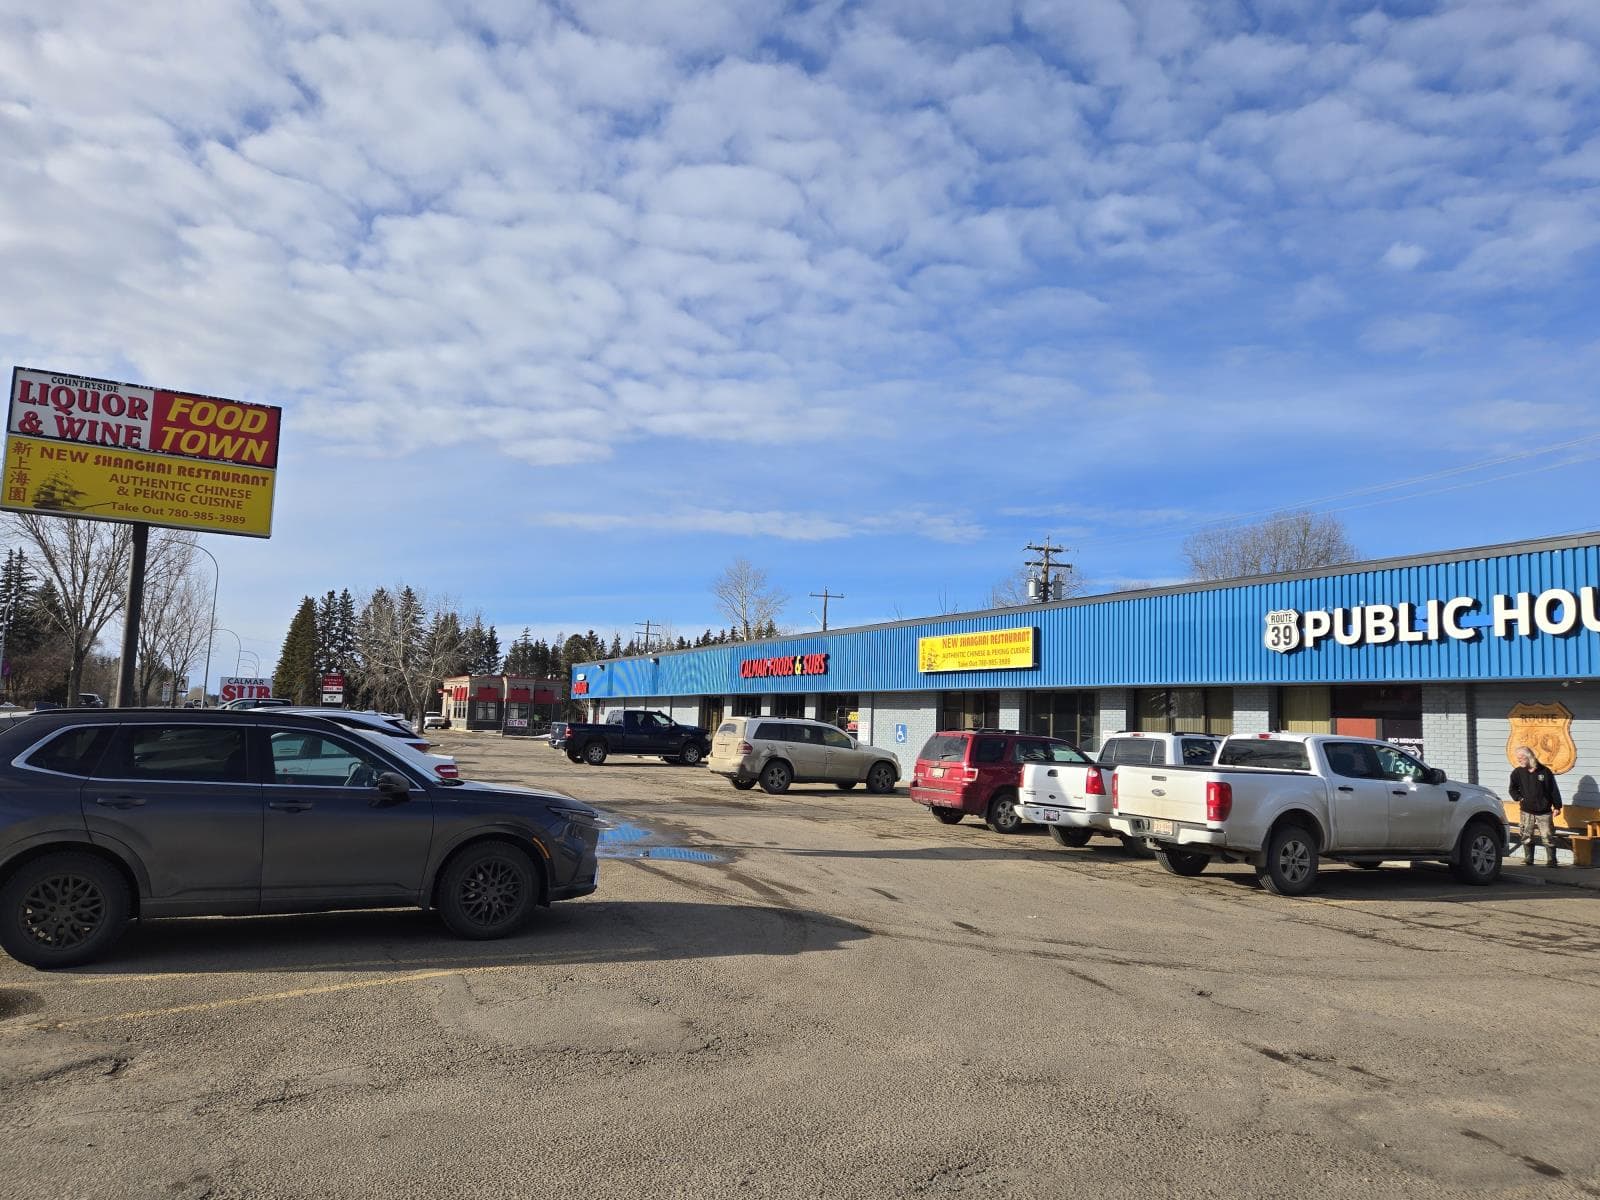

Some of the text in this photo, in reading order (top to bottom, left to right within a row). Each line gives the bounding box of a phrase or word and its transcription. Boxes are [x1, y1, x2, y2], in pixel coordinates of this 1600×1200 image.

[51, 376, 119, 393] COUNTRYSIDE
[18, 380, 149, 421] LIQUOR
[166, 397, 268, 434] FOOD
[18, 410, 142, 449] & WINE
[161, 426, 269, 463] TOWN
[40, 446, 269, 487] NEW SHANGHAI RESTAURANT
[109, 473, 253, 500] AUTHENTIC CHINESE
[116, 486, 243, 510] & PEKING CUISINE
[110, 501, 246, 525] Take Out 780-985-3989
[1271, 612, 1292, 624] ROUTE
[1303, 596, 1476, 648] PUBLIC
[942, 630, 1030, 649] NEW SHANGHAI RESTAURANT
[1270, 624, 1292, 647] 39
[740, 653, 826, 679] CALMAR FOODS & SUBS
[227, 677, 265, 686] CALMAR
[1519, 713, 1558, 724] ROUTE
